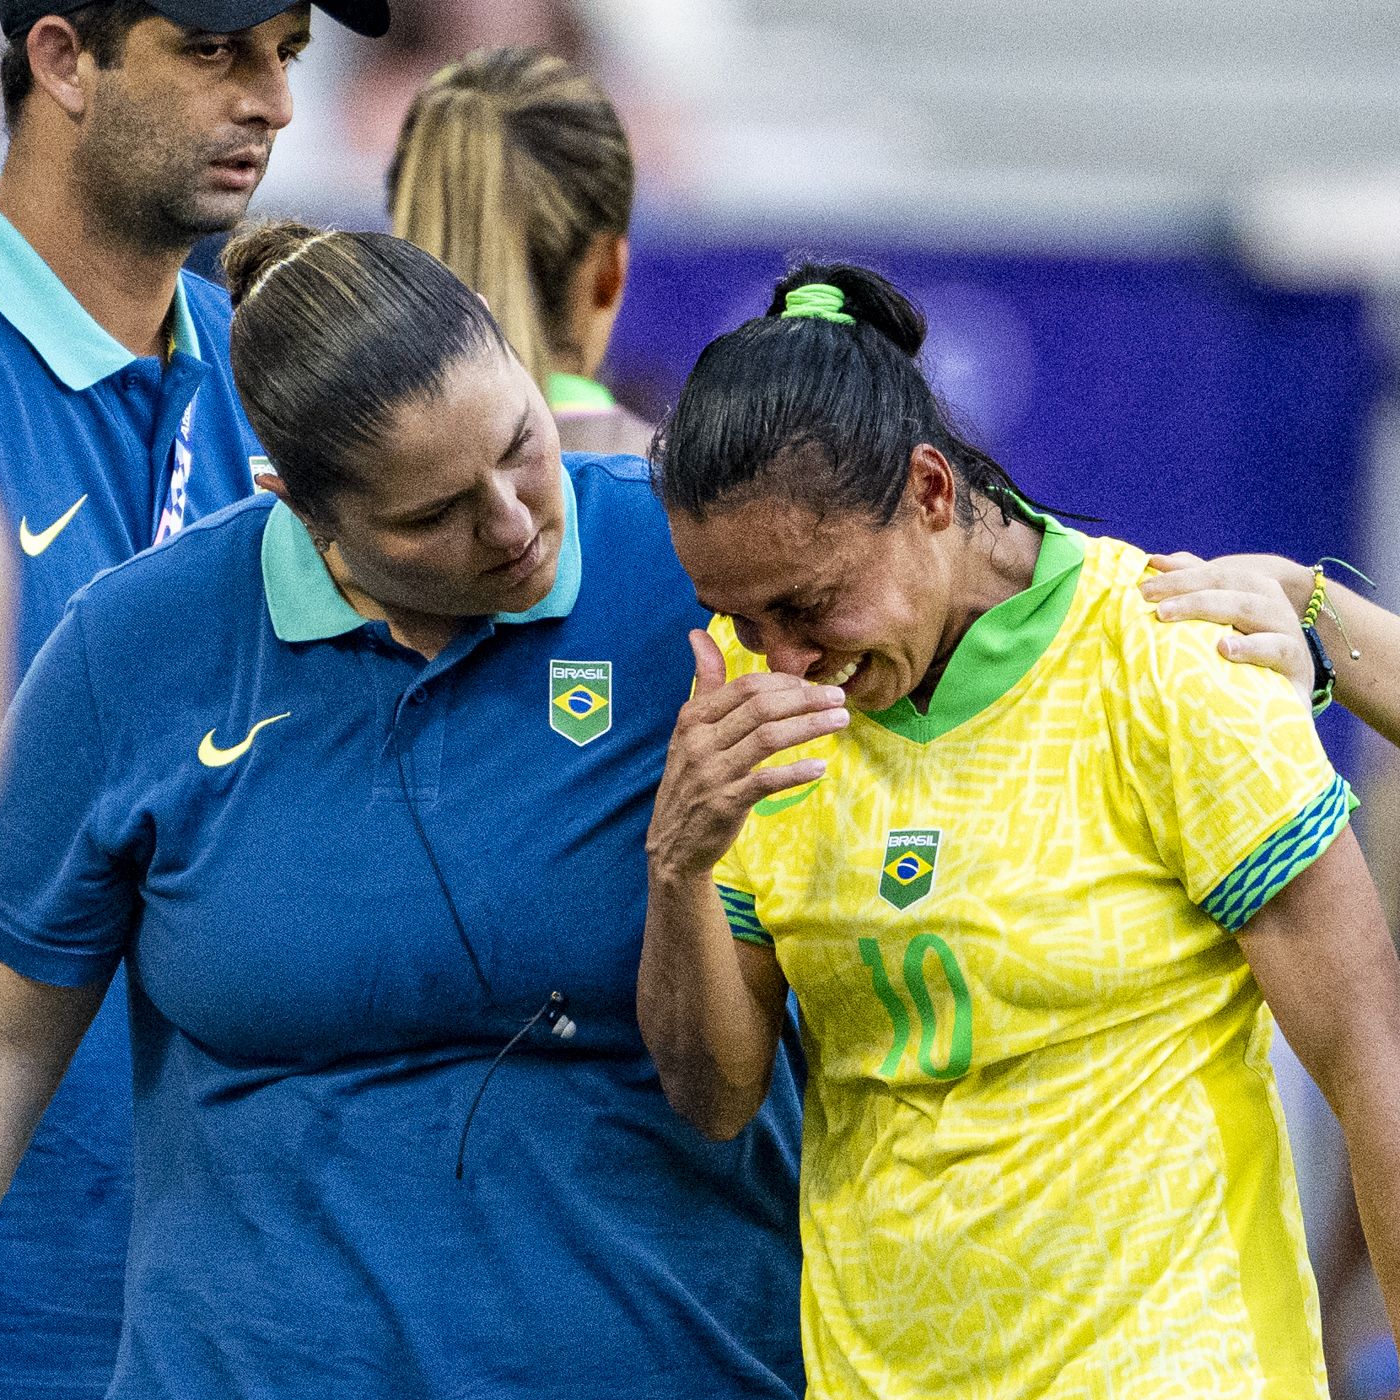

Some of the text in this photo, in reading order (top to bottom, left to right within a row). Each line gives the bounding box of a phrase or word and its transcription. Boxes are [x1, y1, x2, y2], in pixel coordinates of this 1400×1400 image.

[552, 667, 608, 679] BRASIL
[887, 834, 938, 847] BRASIL
[858, 933, 973, 1079] 10
